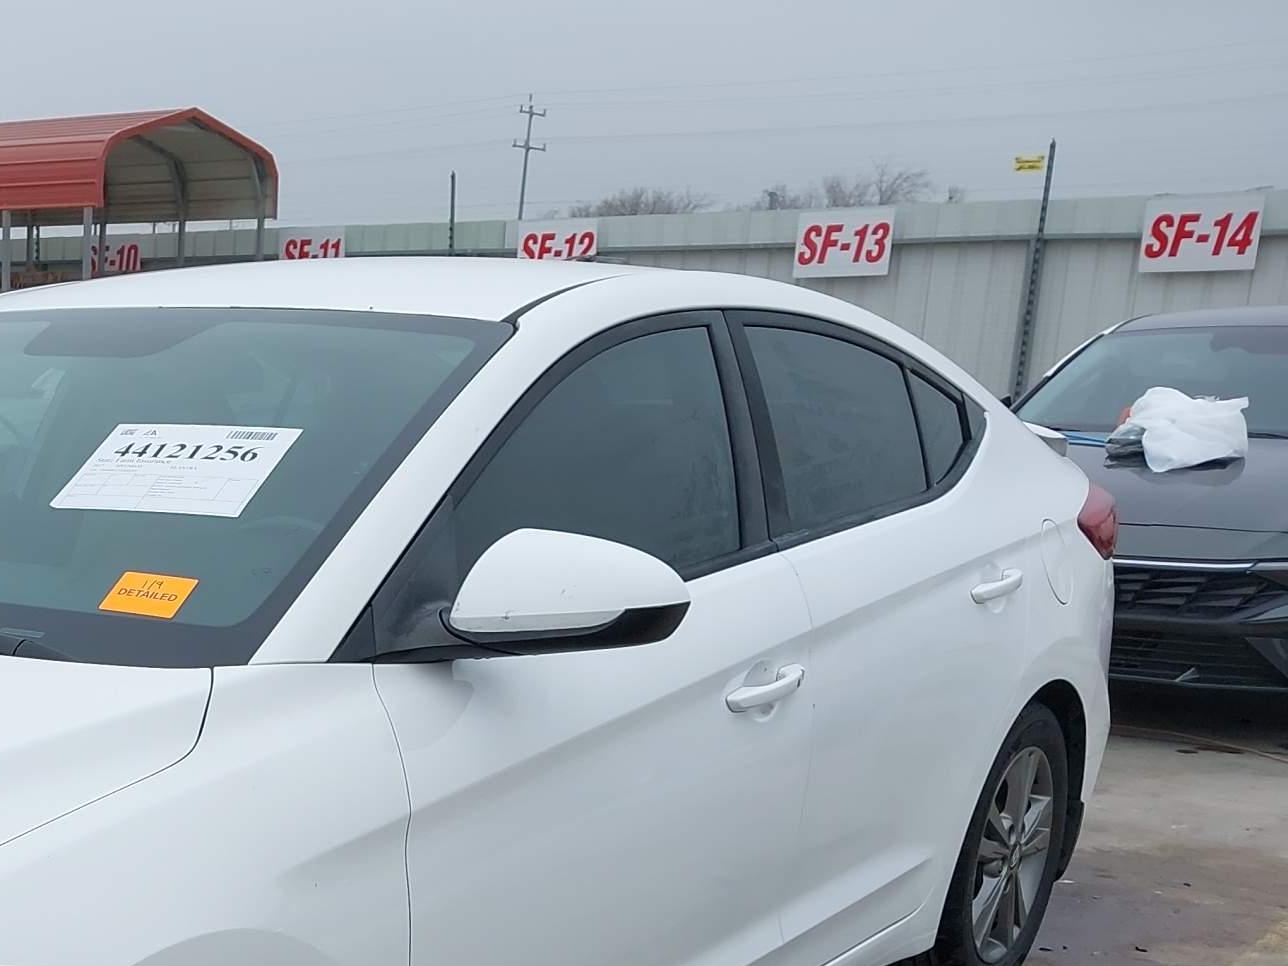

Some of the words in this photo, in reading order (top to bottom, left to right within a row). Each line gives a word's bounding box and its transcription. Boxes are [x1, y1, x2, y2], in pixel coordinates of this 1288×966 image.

[523, 231, 595, 259] SF-12
[797, 221, 891, 266] SF-13
[1144, 211, 1260, 259] SF-14
[114, 441, 264, 463] 44121256
[117, 587, 179, 602] DETAILED
